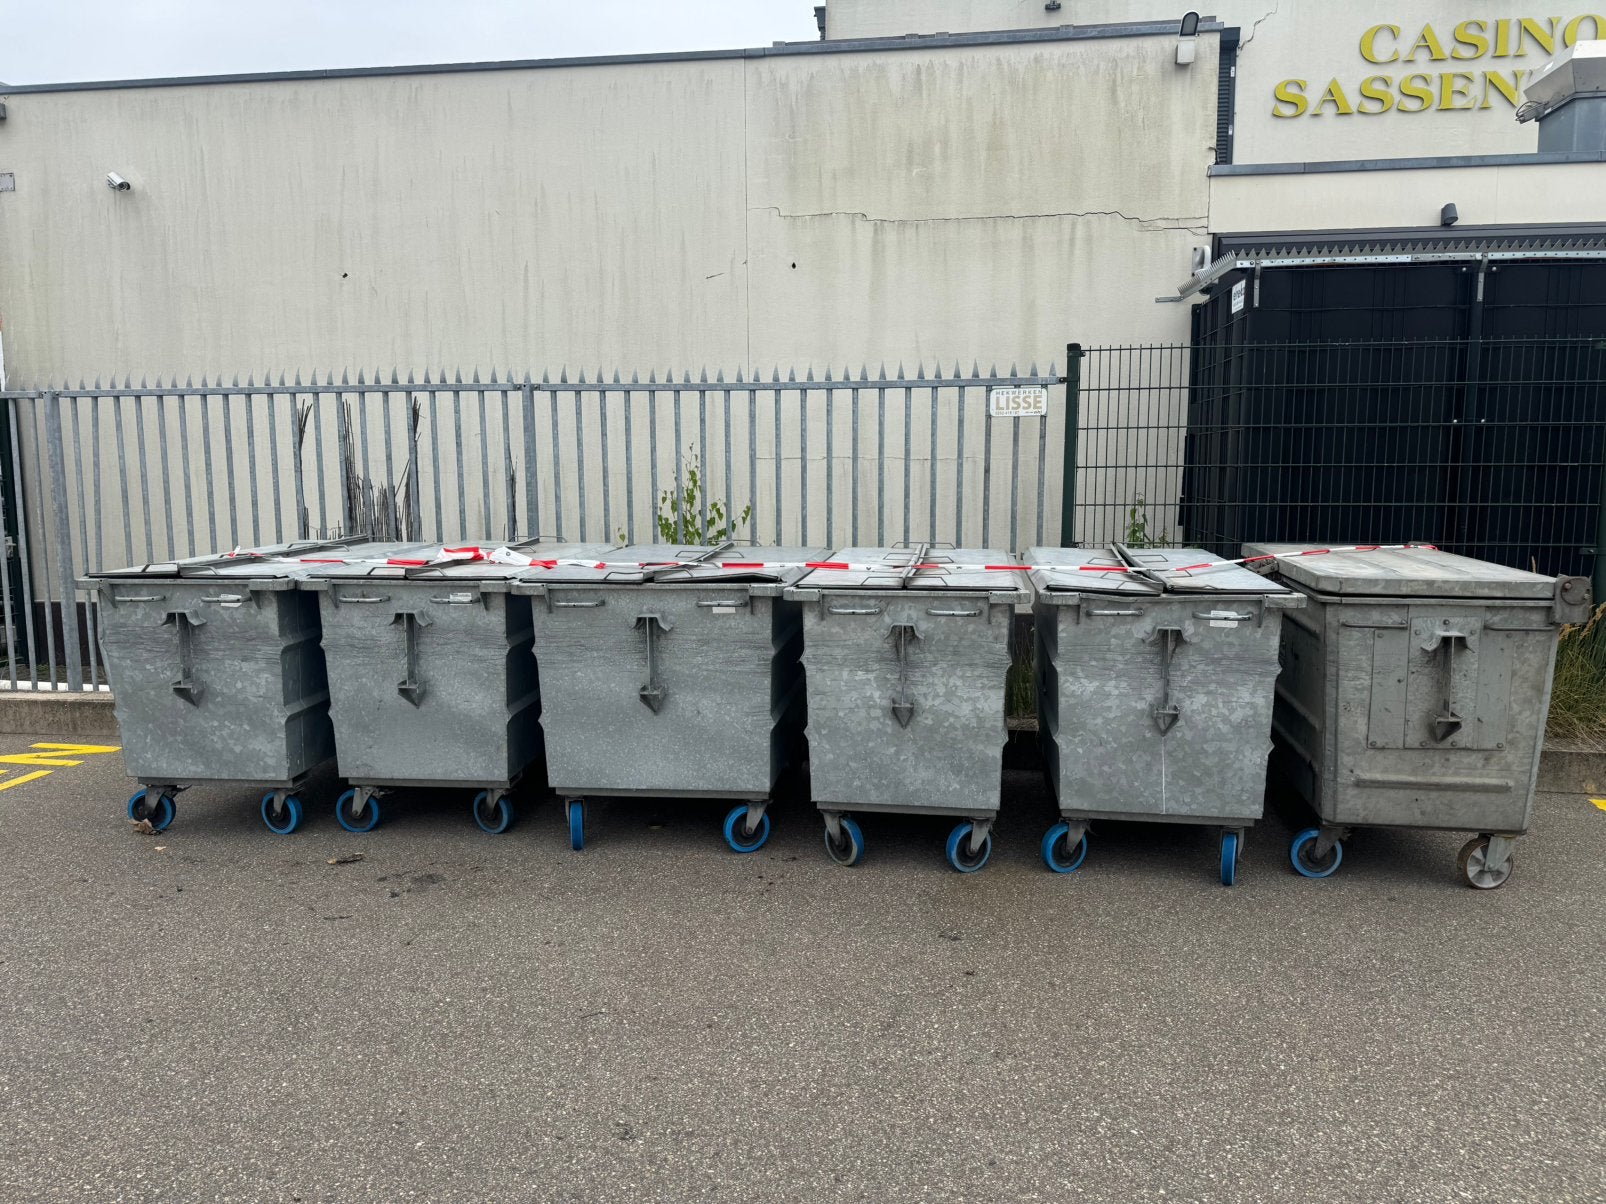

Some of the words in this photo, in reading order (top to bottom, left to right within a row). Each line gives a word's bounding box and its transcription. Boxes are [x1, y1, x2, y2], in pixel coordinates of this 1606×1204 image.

[1360, 15, 1606, 63] CASINO
[1273, 70, 1534, 117] SASSEN
[995, 395, 1042, 410] LISSE
